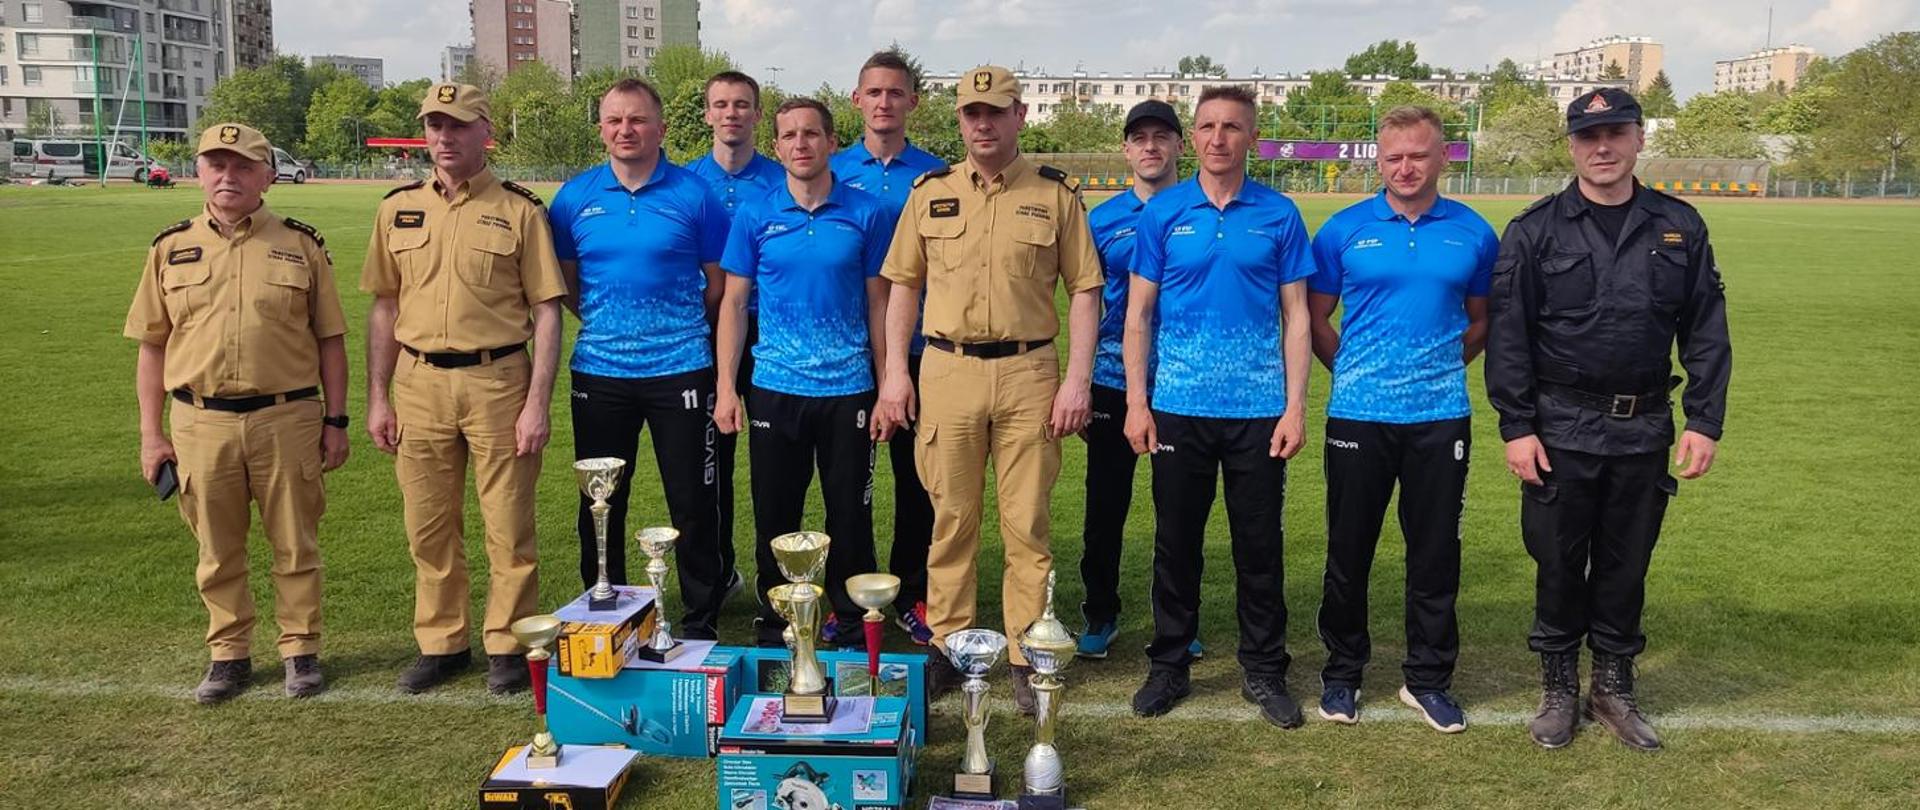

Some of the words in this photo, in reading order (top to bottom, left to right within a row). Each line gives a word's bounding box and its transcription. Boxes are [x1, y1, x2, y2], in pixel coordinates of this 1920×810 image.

[1339, 144, 1349, 159] 2
[1354, 144, 1377, 159] LIG
[682, 388, 698, 409] 11
[856, 409, 866, 428] 9
[1454, 440, 1464, 460] 6
